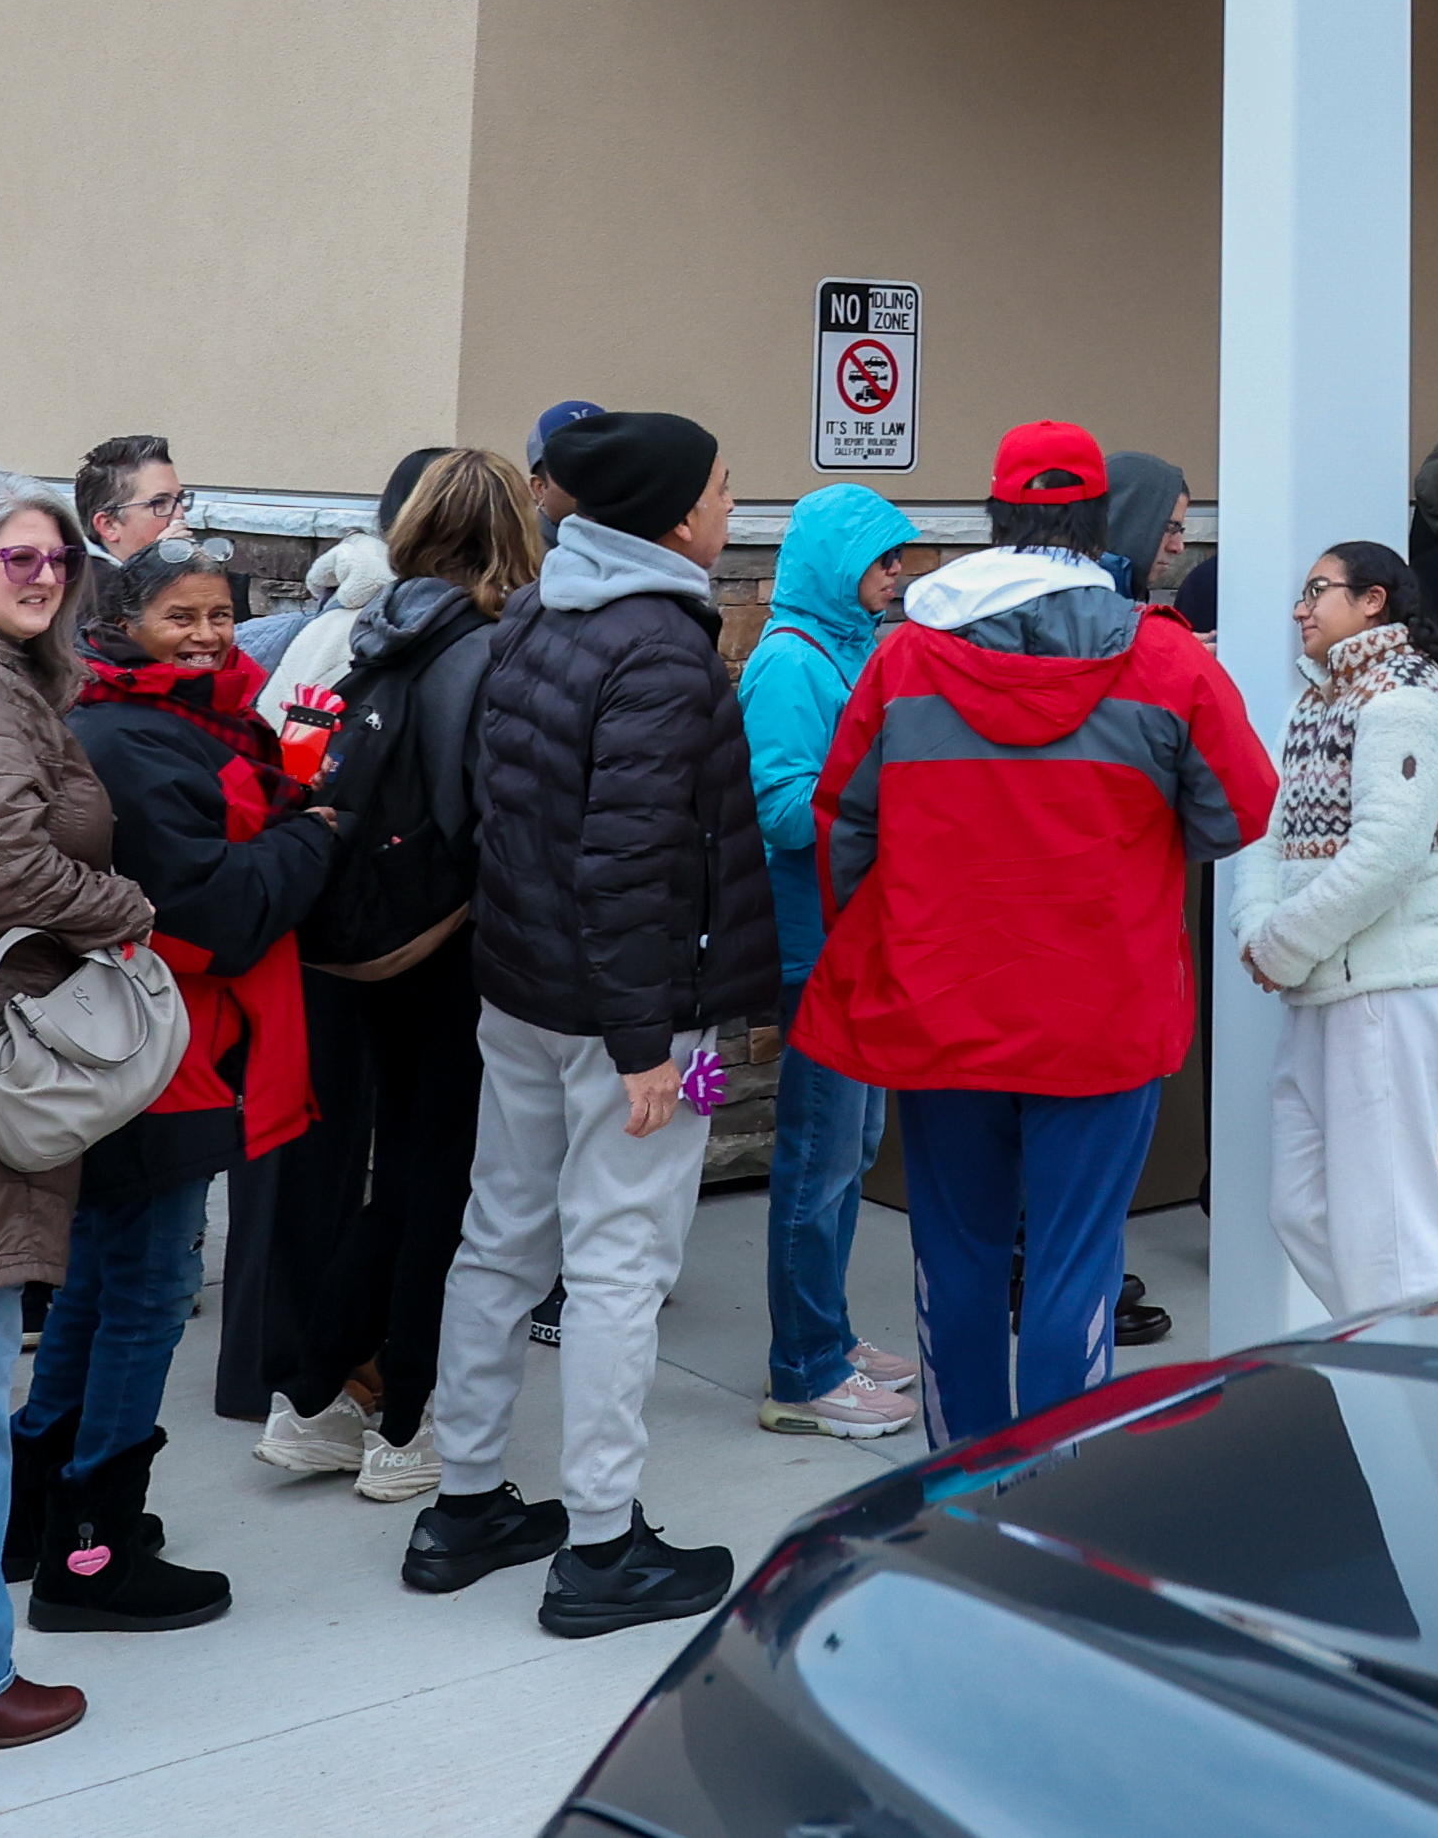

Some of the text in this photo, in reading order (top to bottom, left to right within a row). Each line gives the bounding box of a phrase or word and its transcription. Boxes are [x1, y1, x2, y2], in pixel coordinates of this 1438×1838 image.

[830, 293, 861, 325] NO
[871, 291, 914, 310] IDLING
[874, 312, 910, 330] ZONE
[826, 421, 906, 436] IT'S THE LAW
[531, 1323, 561, 1341] croc
[379, 1451, 422, 1469] HOKA
